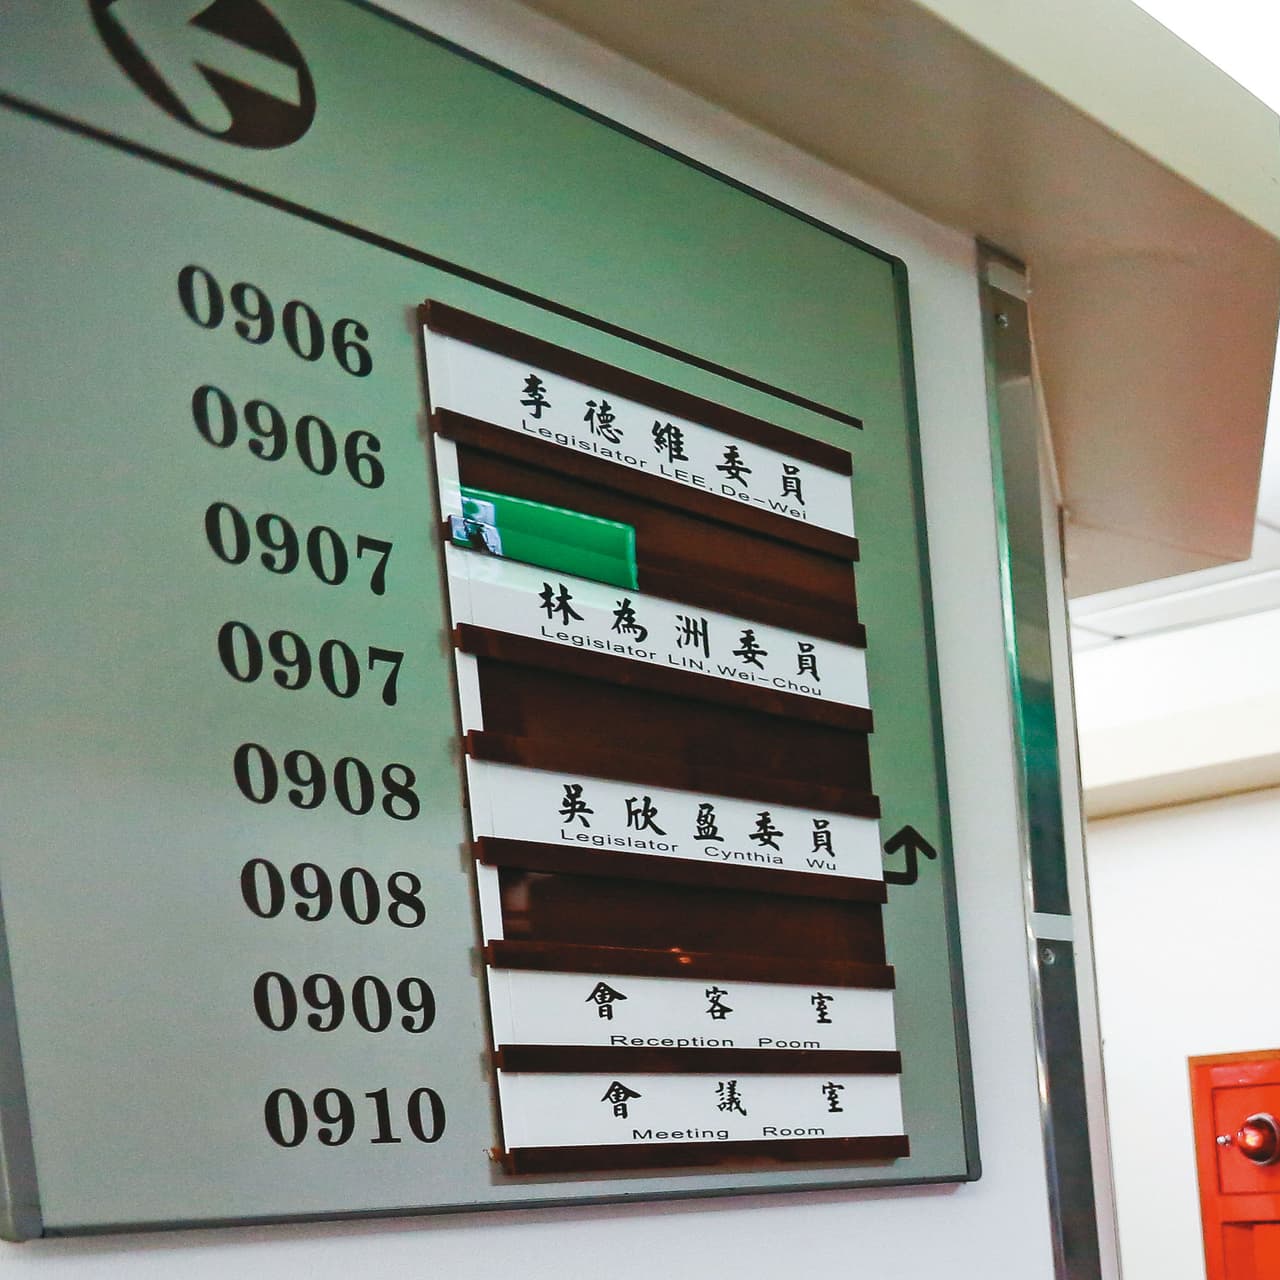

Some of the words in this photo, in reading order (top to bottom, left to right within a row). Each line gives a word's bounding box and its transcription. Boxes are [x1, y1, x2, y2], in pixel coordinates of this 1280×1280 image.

[178, 264, 373, 377] 0906
[191, 384, 385, 489] 0906
[519, 373, 805, 506] 李德維委員
[521, 418, 648, 468] Legislator
[720, 483, 808, 520] De-Wei
[205, 501, 393, 596] 0907
[218, 620, 404, 706] 0907
[538, 582, 821, 682] 林為洲委員
[540, 625, 657, 660] Legislator
[717, 664, 822, 696] Wei-Chou
[233, 742, 420, 821] 0908
[558, 783, 836, 858] 吳欣盈委員
[560, 829, 679, 853] Legislator
[704, 846, 785, 865] Cynthia
[806, 858, 837, 871] Wu
[240, 858, 426, 928] 0908
[253, 971, 436, 1034] 0909
[584, 981, 834, 1024] 會客室
[610, 1035, 735, 1048] Reception
[264, 1087, 446, 1148] 0910
[600, 1081, 845, 1120] 會議室
[632, 1127, 729, 1140] Meeting
[762, 1126, 826, 1137] Room
